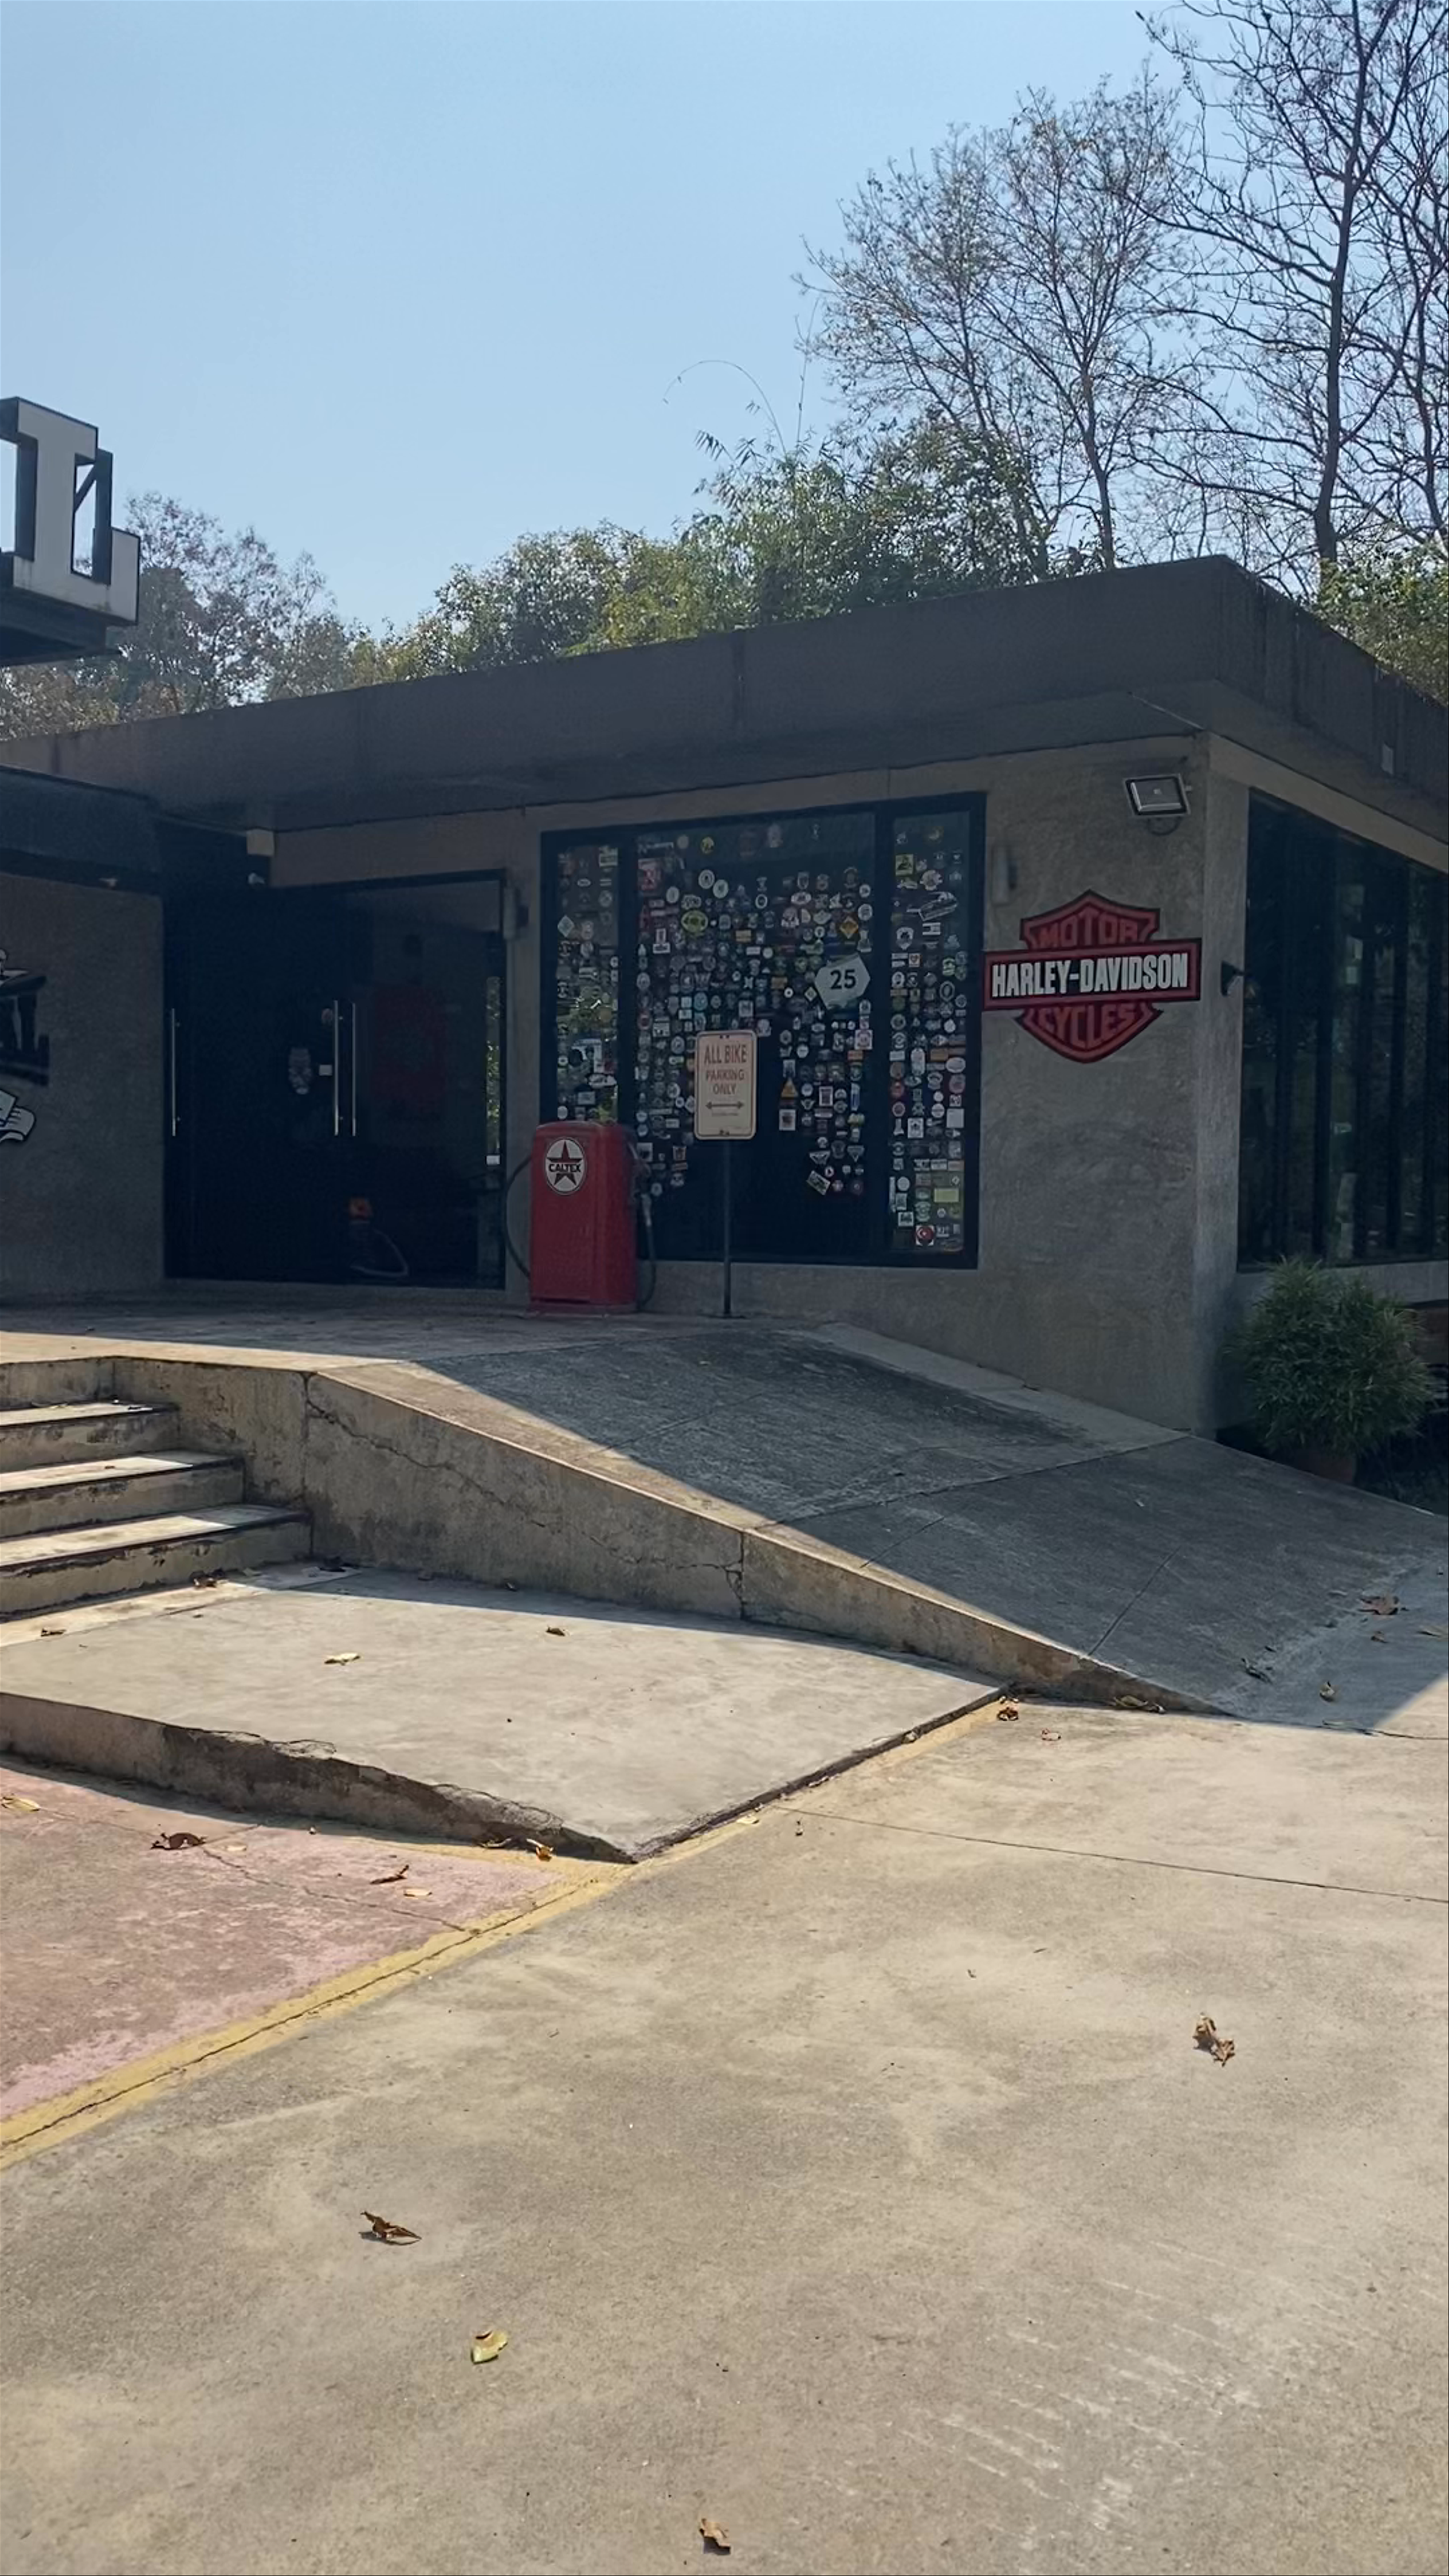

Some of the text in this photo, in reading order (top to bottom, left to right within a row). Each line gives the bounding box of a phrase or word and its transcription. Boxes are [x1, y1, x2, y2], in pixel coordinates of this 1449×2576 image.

[1038, 907, 1138, 948] MOTOR
[831, 969, 856, 990] 25
[992, 953, 1188, 997] HARLEY-DAVIDSON
[1038, 1002, 1135, 1049] CYCLES
[704, 1044, 747, 1064] ALL BIKE
[706, 1069, 744, 1081] PARKING
[713, 1083, 737, 1095] ONLY
[549, 1163, 581, 1172] CALTEX
